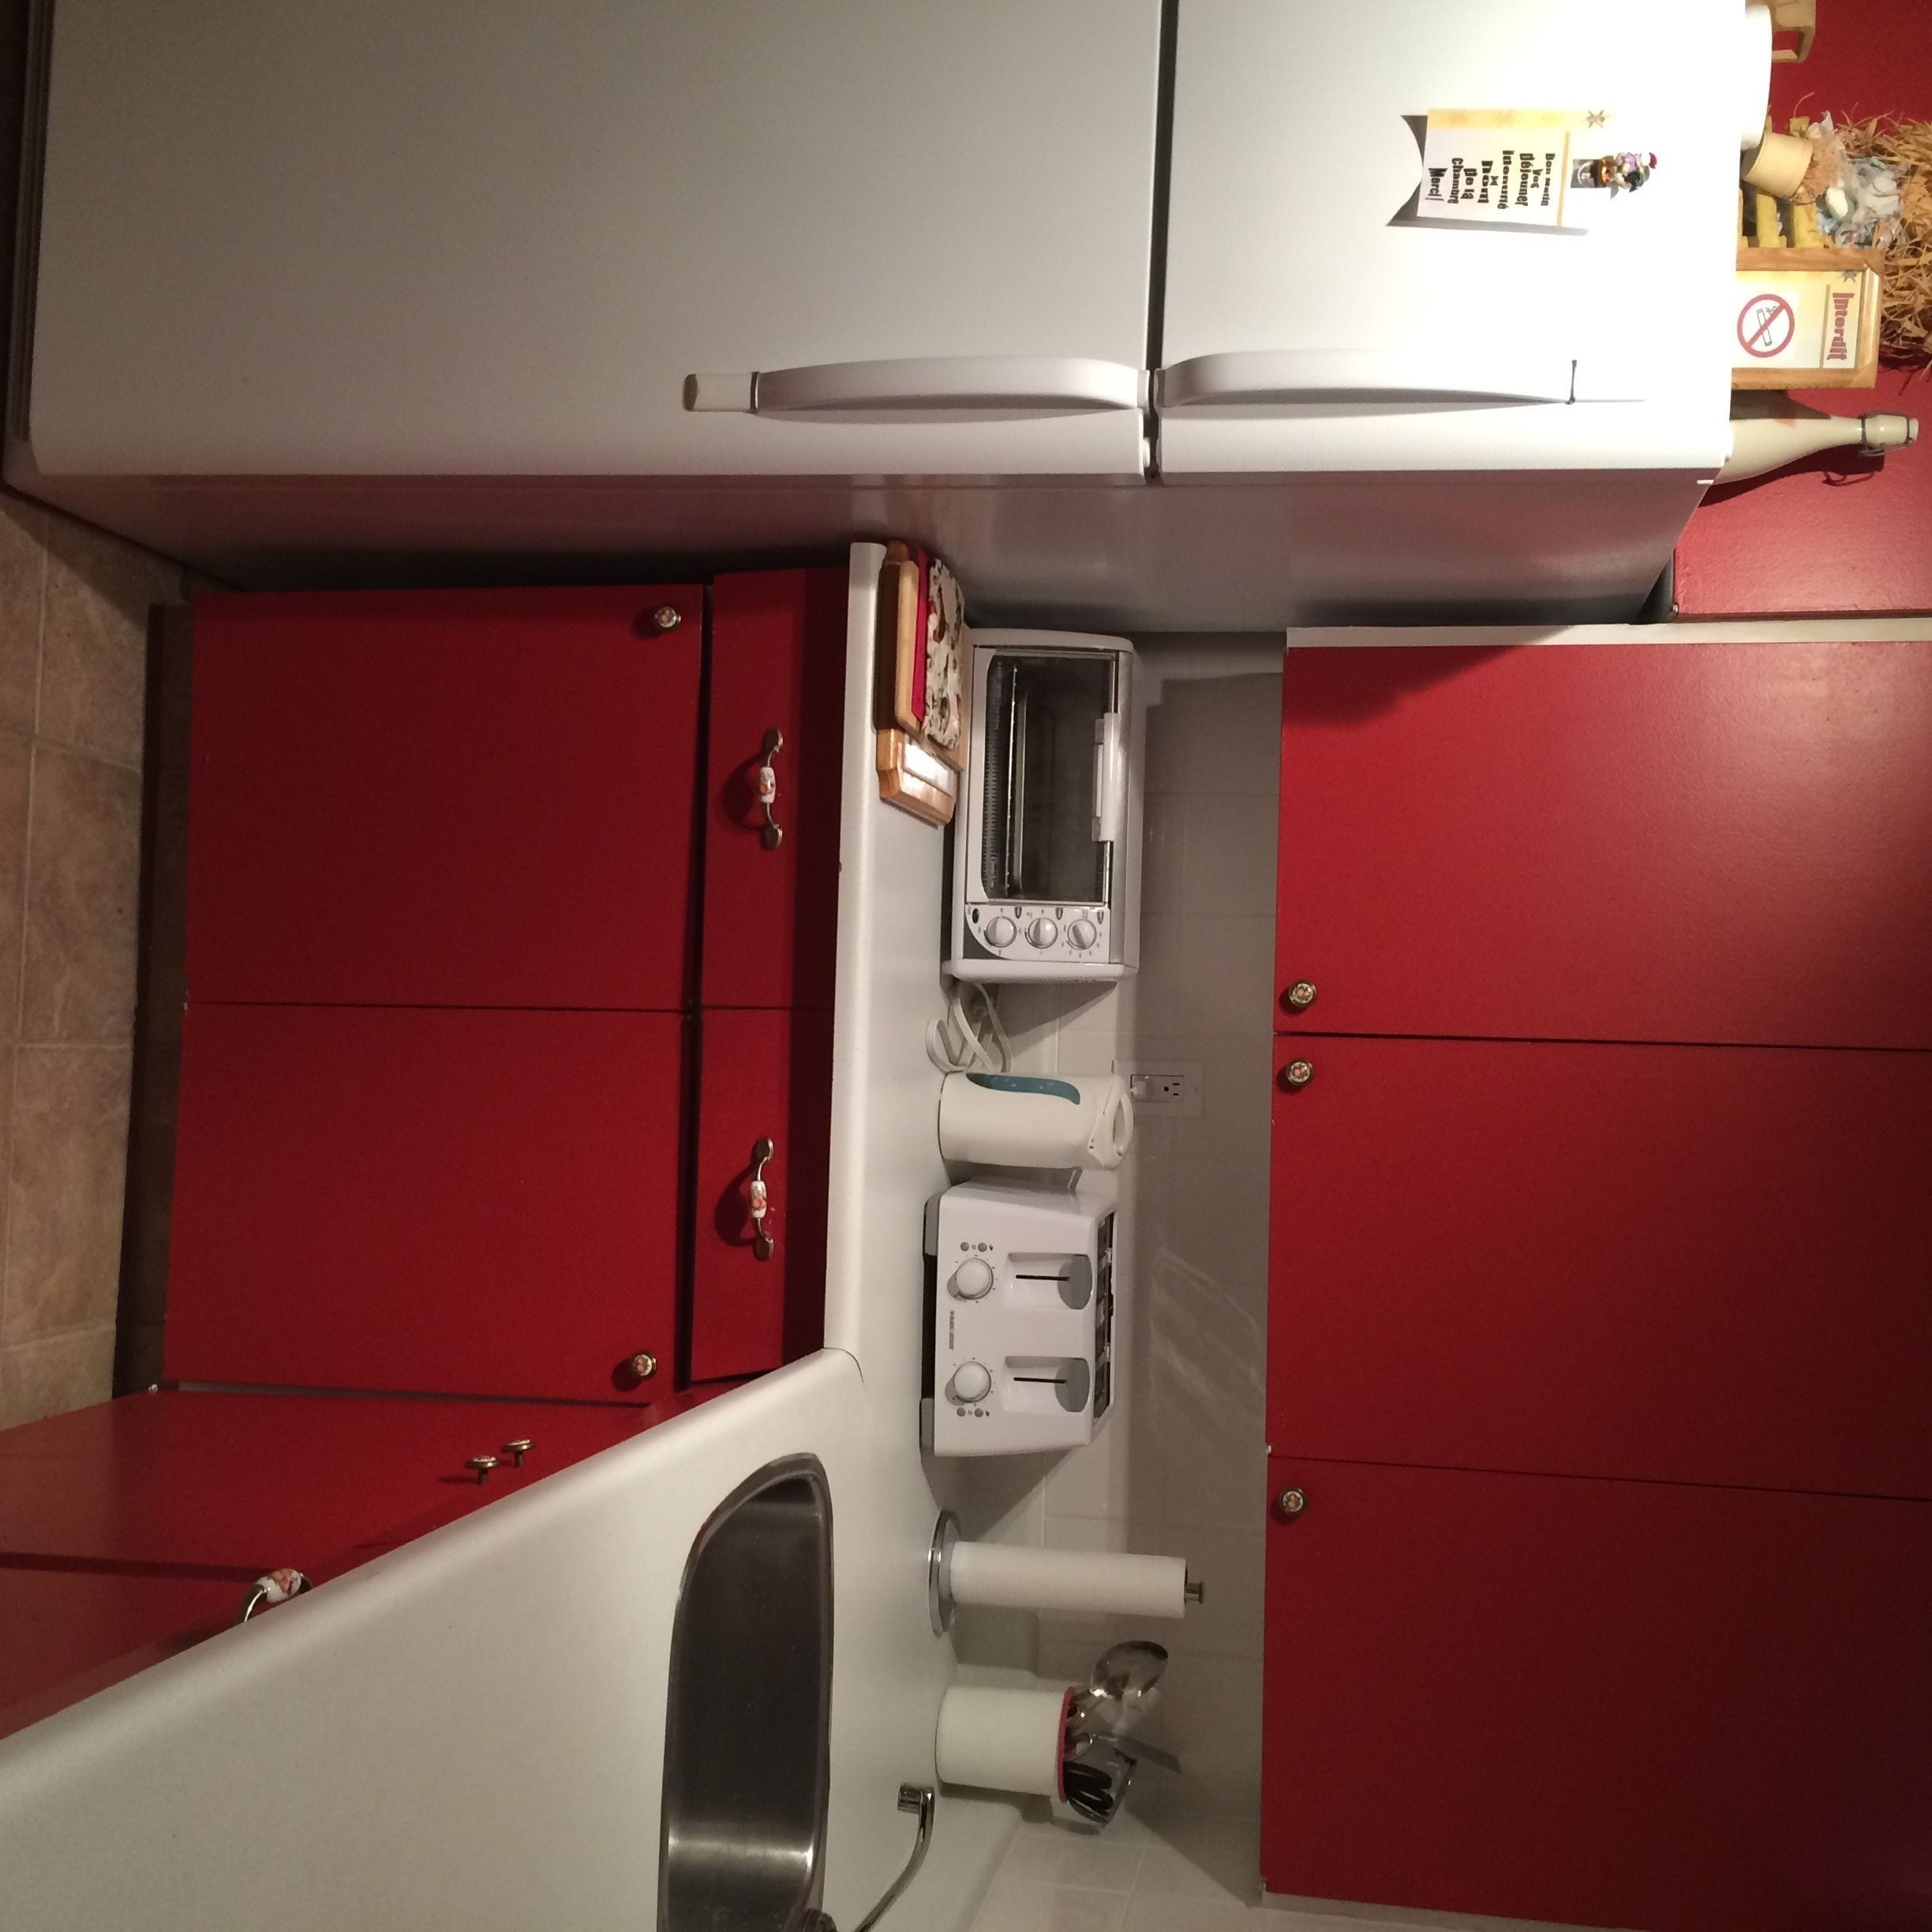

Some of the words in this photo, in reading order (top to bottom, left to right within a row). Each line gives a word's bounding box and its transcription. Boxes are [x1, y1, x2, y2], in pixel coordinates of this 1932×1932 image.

[1545, 153, 1556, 175] Bon
[1477, 160, 1493, 204] nom
[1530, 169, 1544, 189] Vos
[1460, 189, 1475, 200] la
[1826, 292, 1855, 361] Interdit
